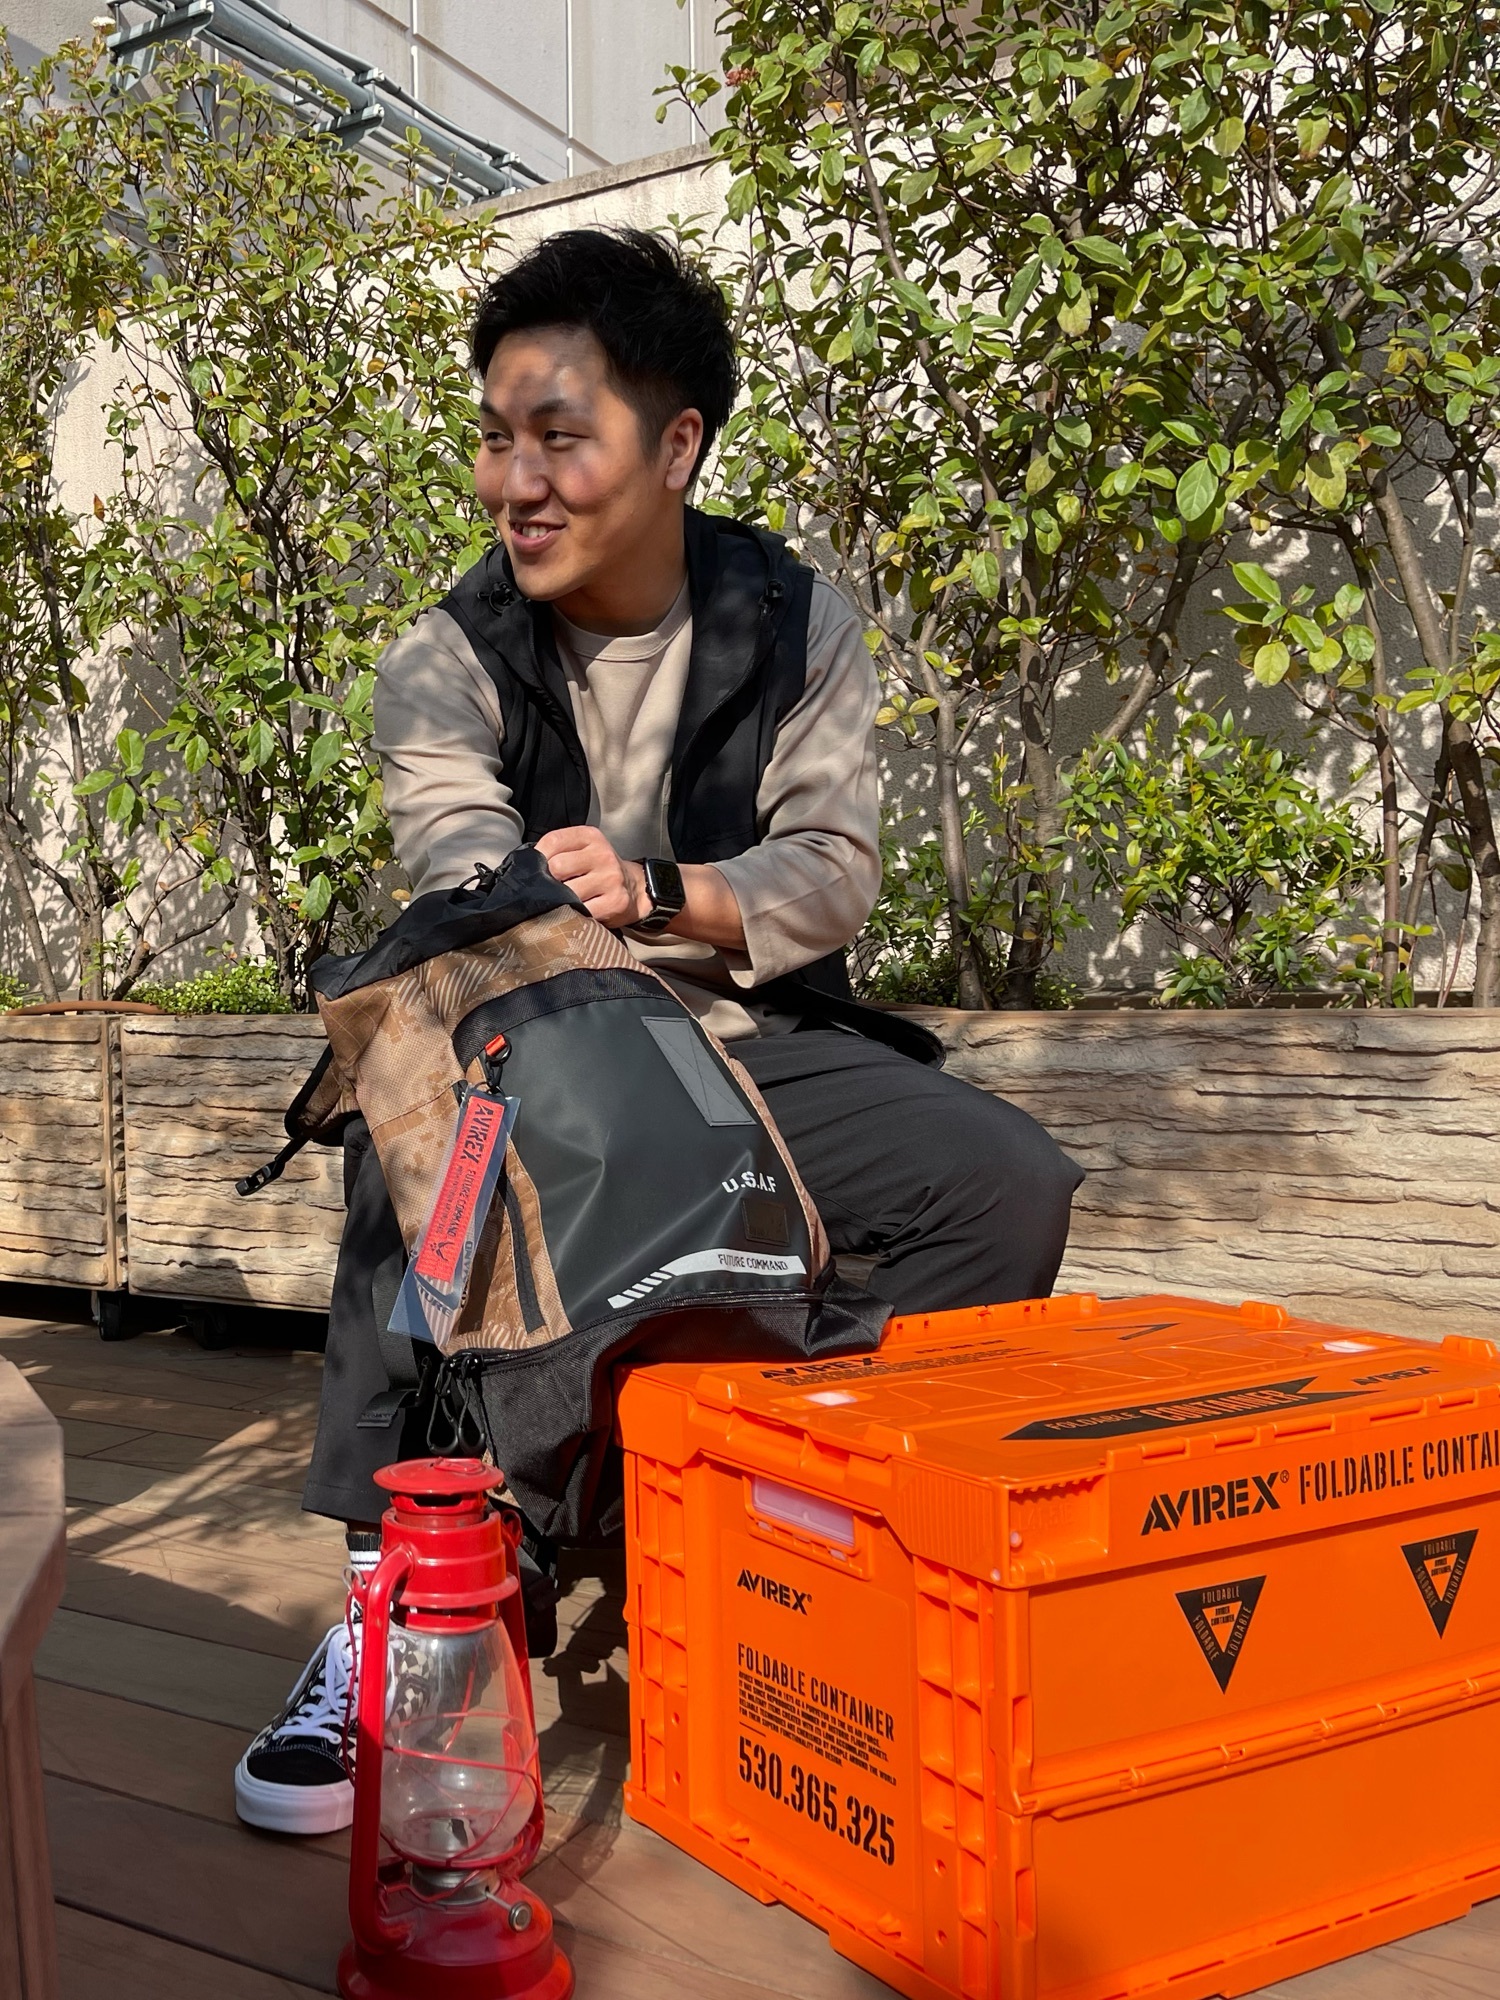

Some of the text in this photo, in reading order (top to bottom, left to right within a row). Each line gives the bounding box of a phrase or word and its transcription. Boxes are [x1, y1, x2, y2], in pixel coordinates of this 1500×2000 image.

[459, 1103, 494, 1164] AVIREX
[721, 1170, 778, 1194] U.S.A.F
[718, 1253, 788, 1272] FUTURE COMMAND
[1044, 1411, 1143, 1431] FOLDABLE
[1299, 1446, 1415, 1505] FOLDABLE
[1423, 1538, 1456, 1556] FOLDABLE
[1202, 1586, 1240, 1604] FOLDABLE
[1415, 1565, 1438, 1608] FOLDABLE
[1443, 1558, 1466, 1604] FOLDABLE
[1192, 1614, 1220, 1661] FOLDABLE
[1227, 1606, 1252, 1657] FOLDABLE
[738, 1643, 895, 1742] FOLDABLE CONTAINER
[738, 1736, 896, 1867] 530.365.325
